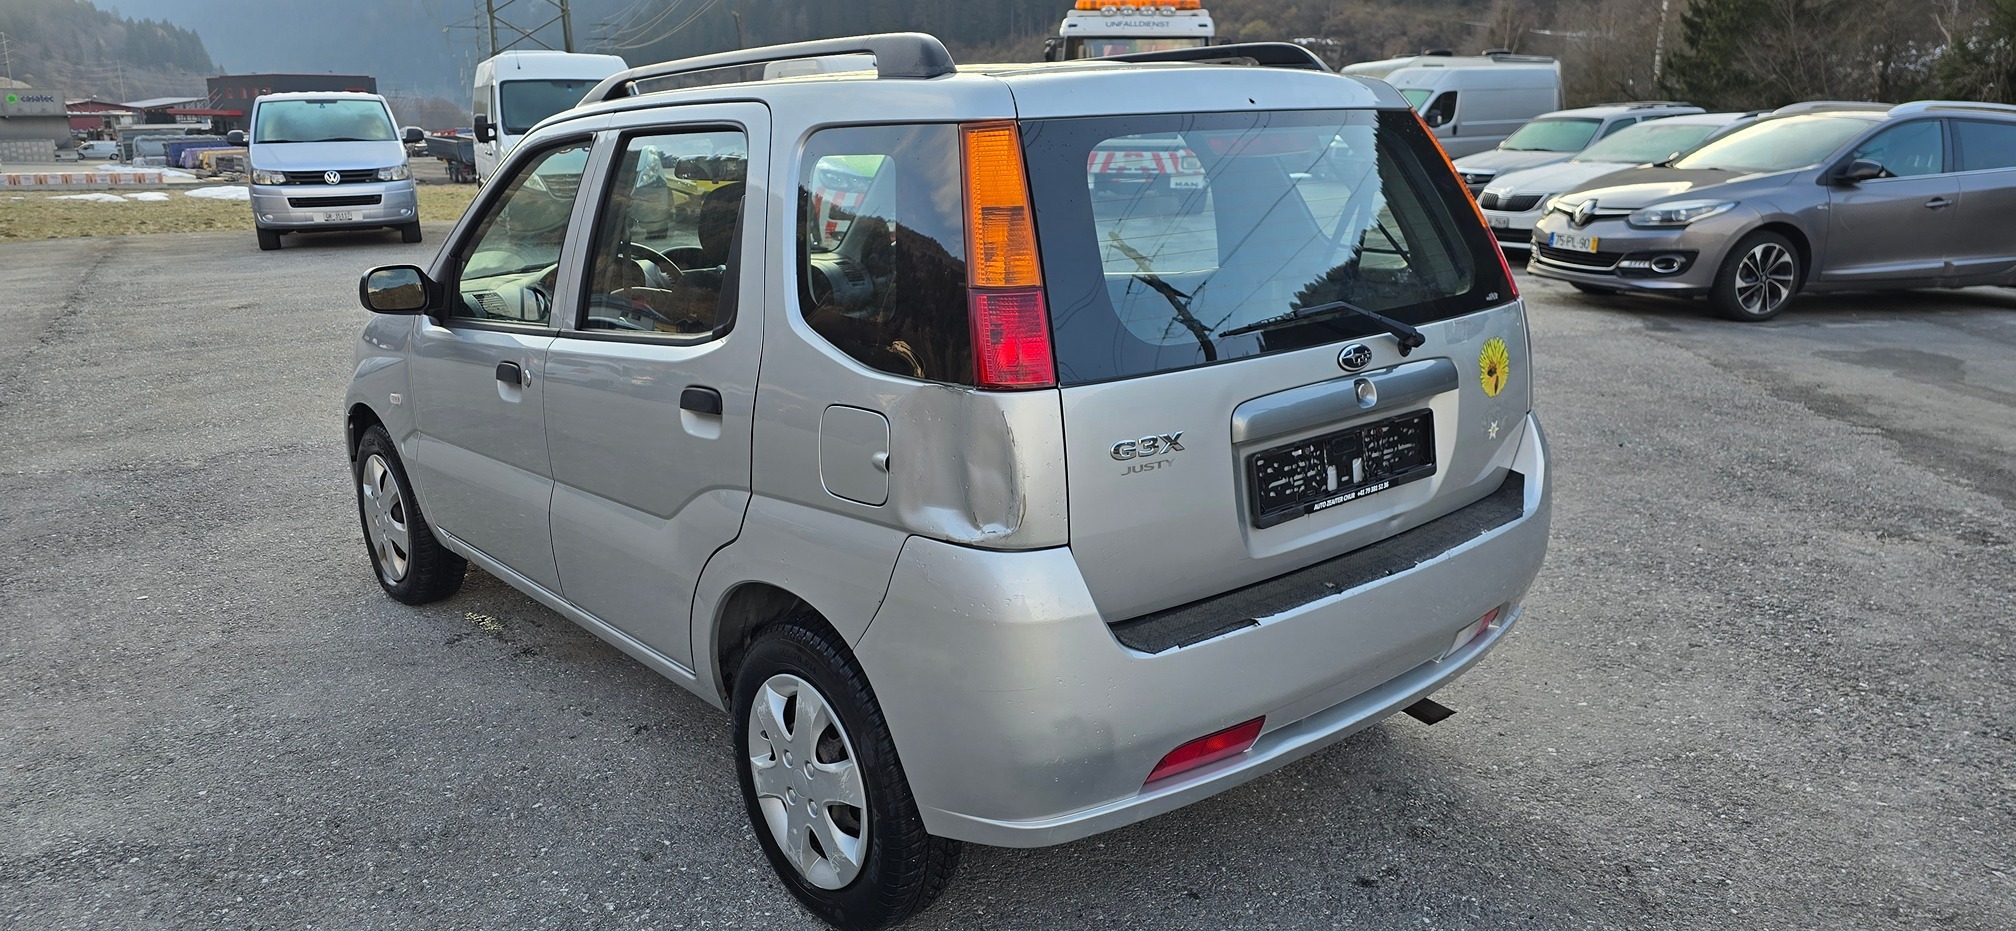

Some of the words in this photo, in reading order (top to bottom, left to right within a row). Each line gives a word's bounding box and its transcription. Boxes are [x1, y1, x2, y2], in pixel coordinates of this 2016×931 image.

[1105, 20, 1170, 28] UNFALLDIENST
[20, 95, 54, 103] casatec
[1110, 430, 1185, 461] G3X
[1121, 458, 1176, 476] JUSTY
[1313, 501, 1326, 510] AUTO
